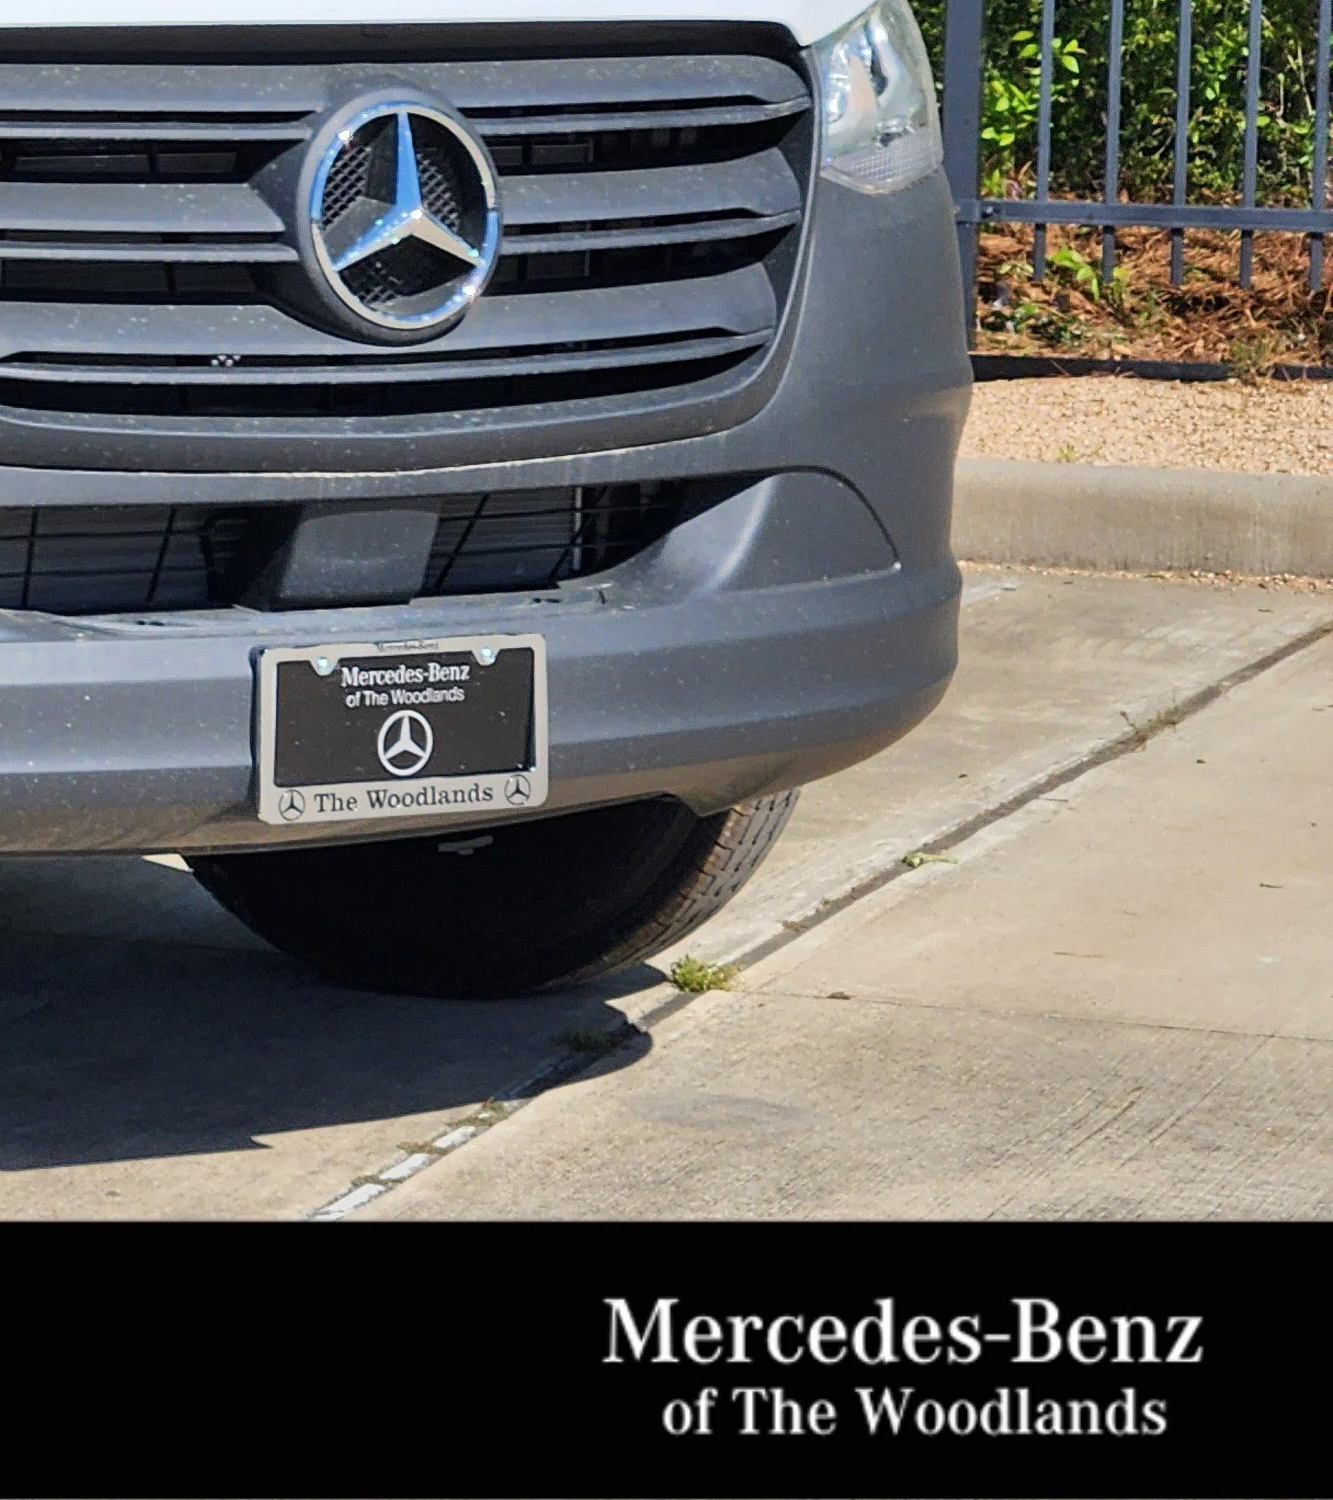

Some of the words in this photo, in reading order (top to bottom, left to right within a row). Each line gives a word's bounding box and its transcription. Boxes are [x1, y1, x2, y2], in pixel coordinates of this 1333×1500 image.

[340, 662, 471, 688] Mercedes-Benz
[345, 690, 362, 708] of
[362, 689, 390, 707] The
[390, 686, 465, 705] Woodlands
[314, 792, 358, 814] The
[366, 783, 493, 809] Woodlands
